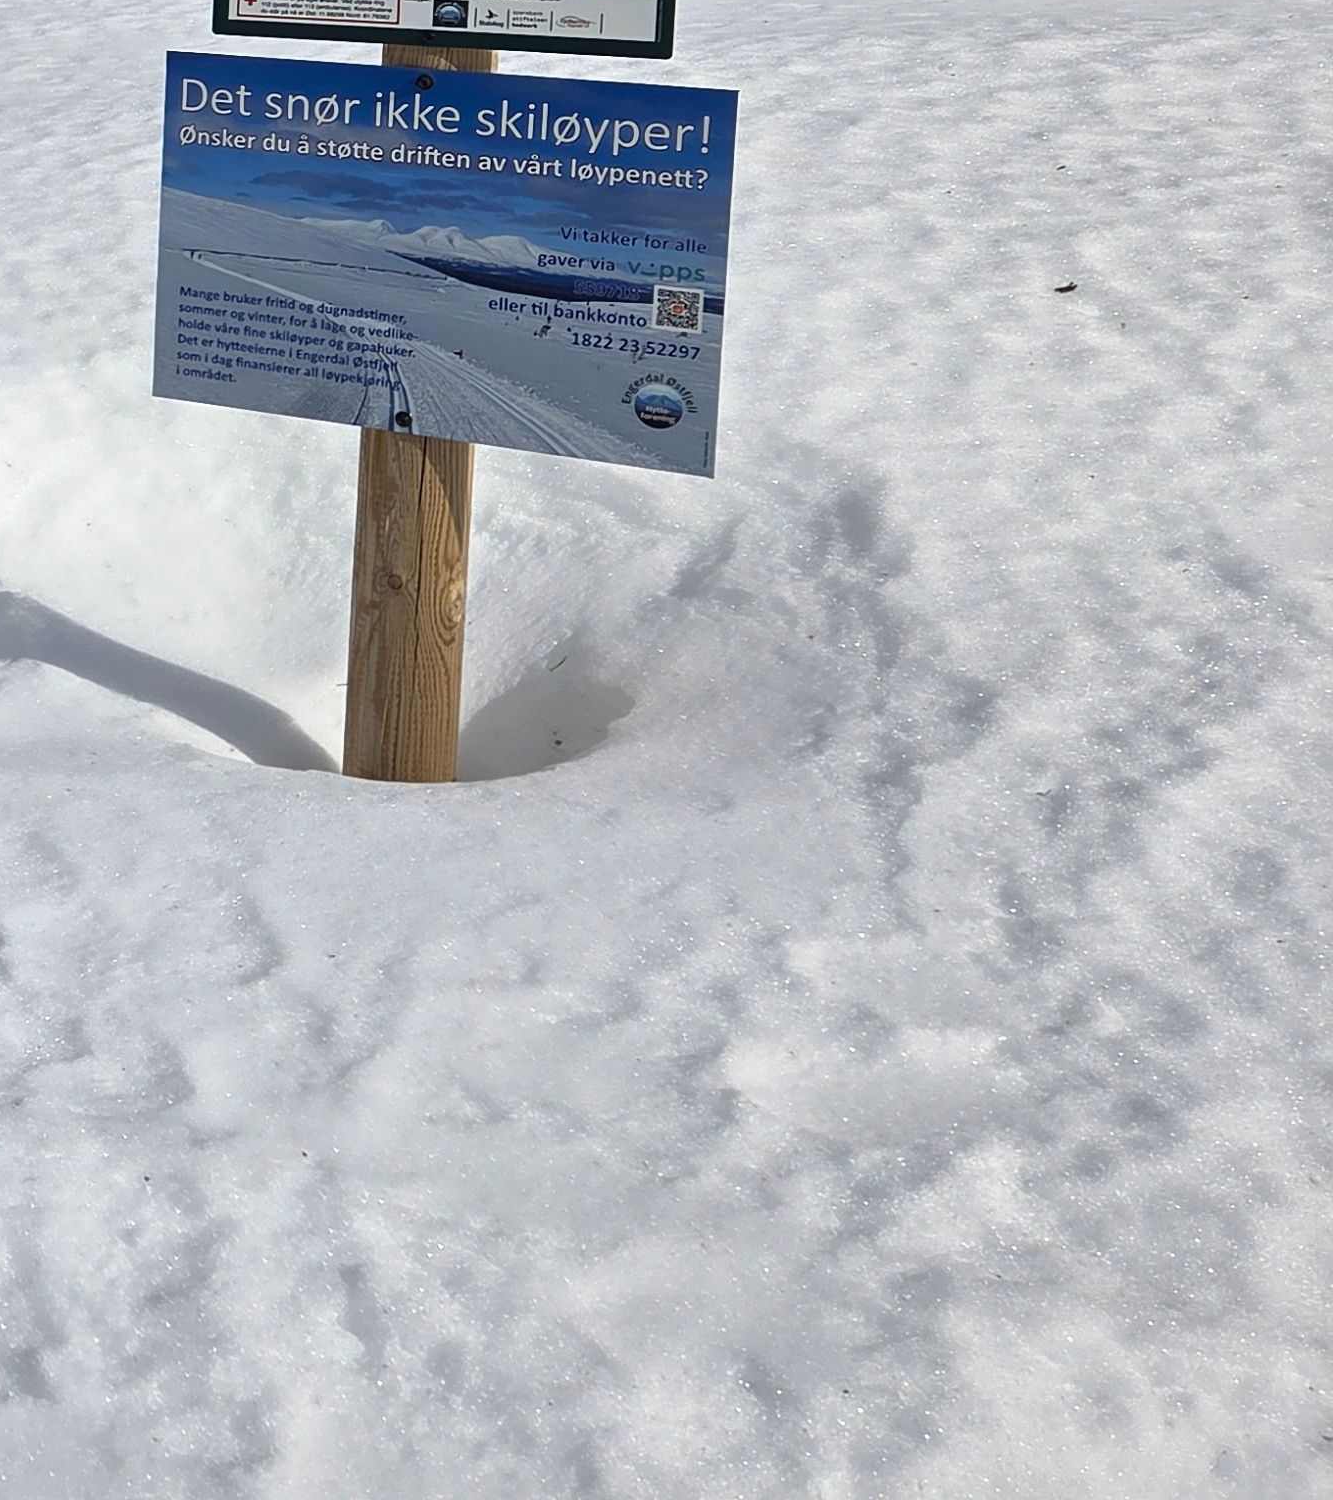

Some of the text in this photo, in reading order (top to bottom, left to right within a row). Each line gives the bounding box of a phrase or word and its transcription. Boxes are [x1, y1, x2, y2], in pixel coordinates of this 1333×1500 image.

[181, 78, 711, 156] Det snør ikke skiløyper!
[180, 124, 709, 190] Ønsker du å støtte driften av vårt løypenett?
[560, 226, 707, 254] Vi takker for alle
[537, 253, 585, 269] gaver
[590, 257, 616, 272] via
[179, 303, 419, 341] sommer og vinter, for å lage og vedlike-
[180, 286, 407, 325] Mange bruker fritid og dugnadstimer,
[489, 297, 648, 328] eller til bankkonto
[178, 317, 416, 358] holde våre fine skiløyper og gapahuker.
[178, 333, 198, 345] Det
[201, 339, 214, 347] er
[217, 338, 286, 357] hytteeierne
[296, 349, 350, 365] Engerdal
[353, 356, 398, 373] Østfjell
[571, 332, 701, 360] 1822 23 52297
[177, 351, 201, 362] som
[211, 353, 233, 368] dag
[236, 356, 301, 376] finansierer
[303, 367, 318, 378] all
[322, 368, 401, 391] løypekjøring
[183, 368, 237, 383] området.
[621, 373, 698, 413] Engerdal Østfjell
